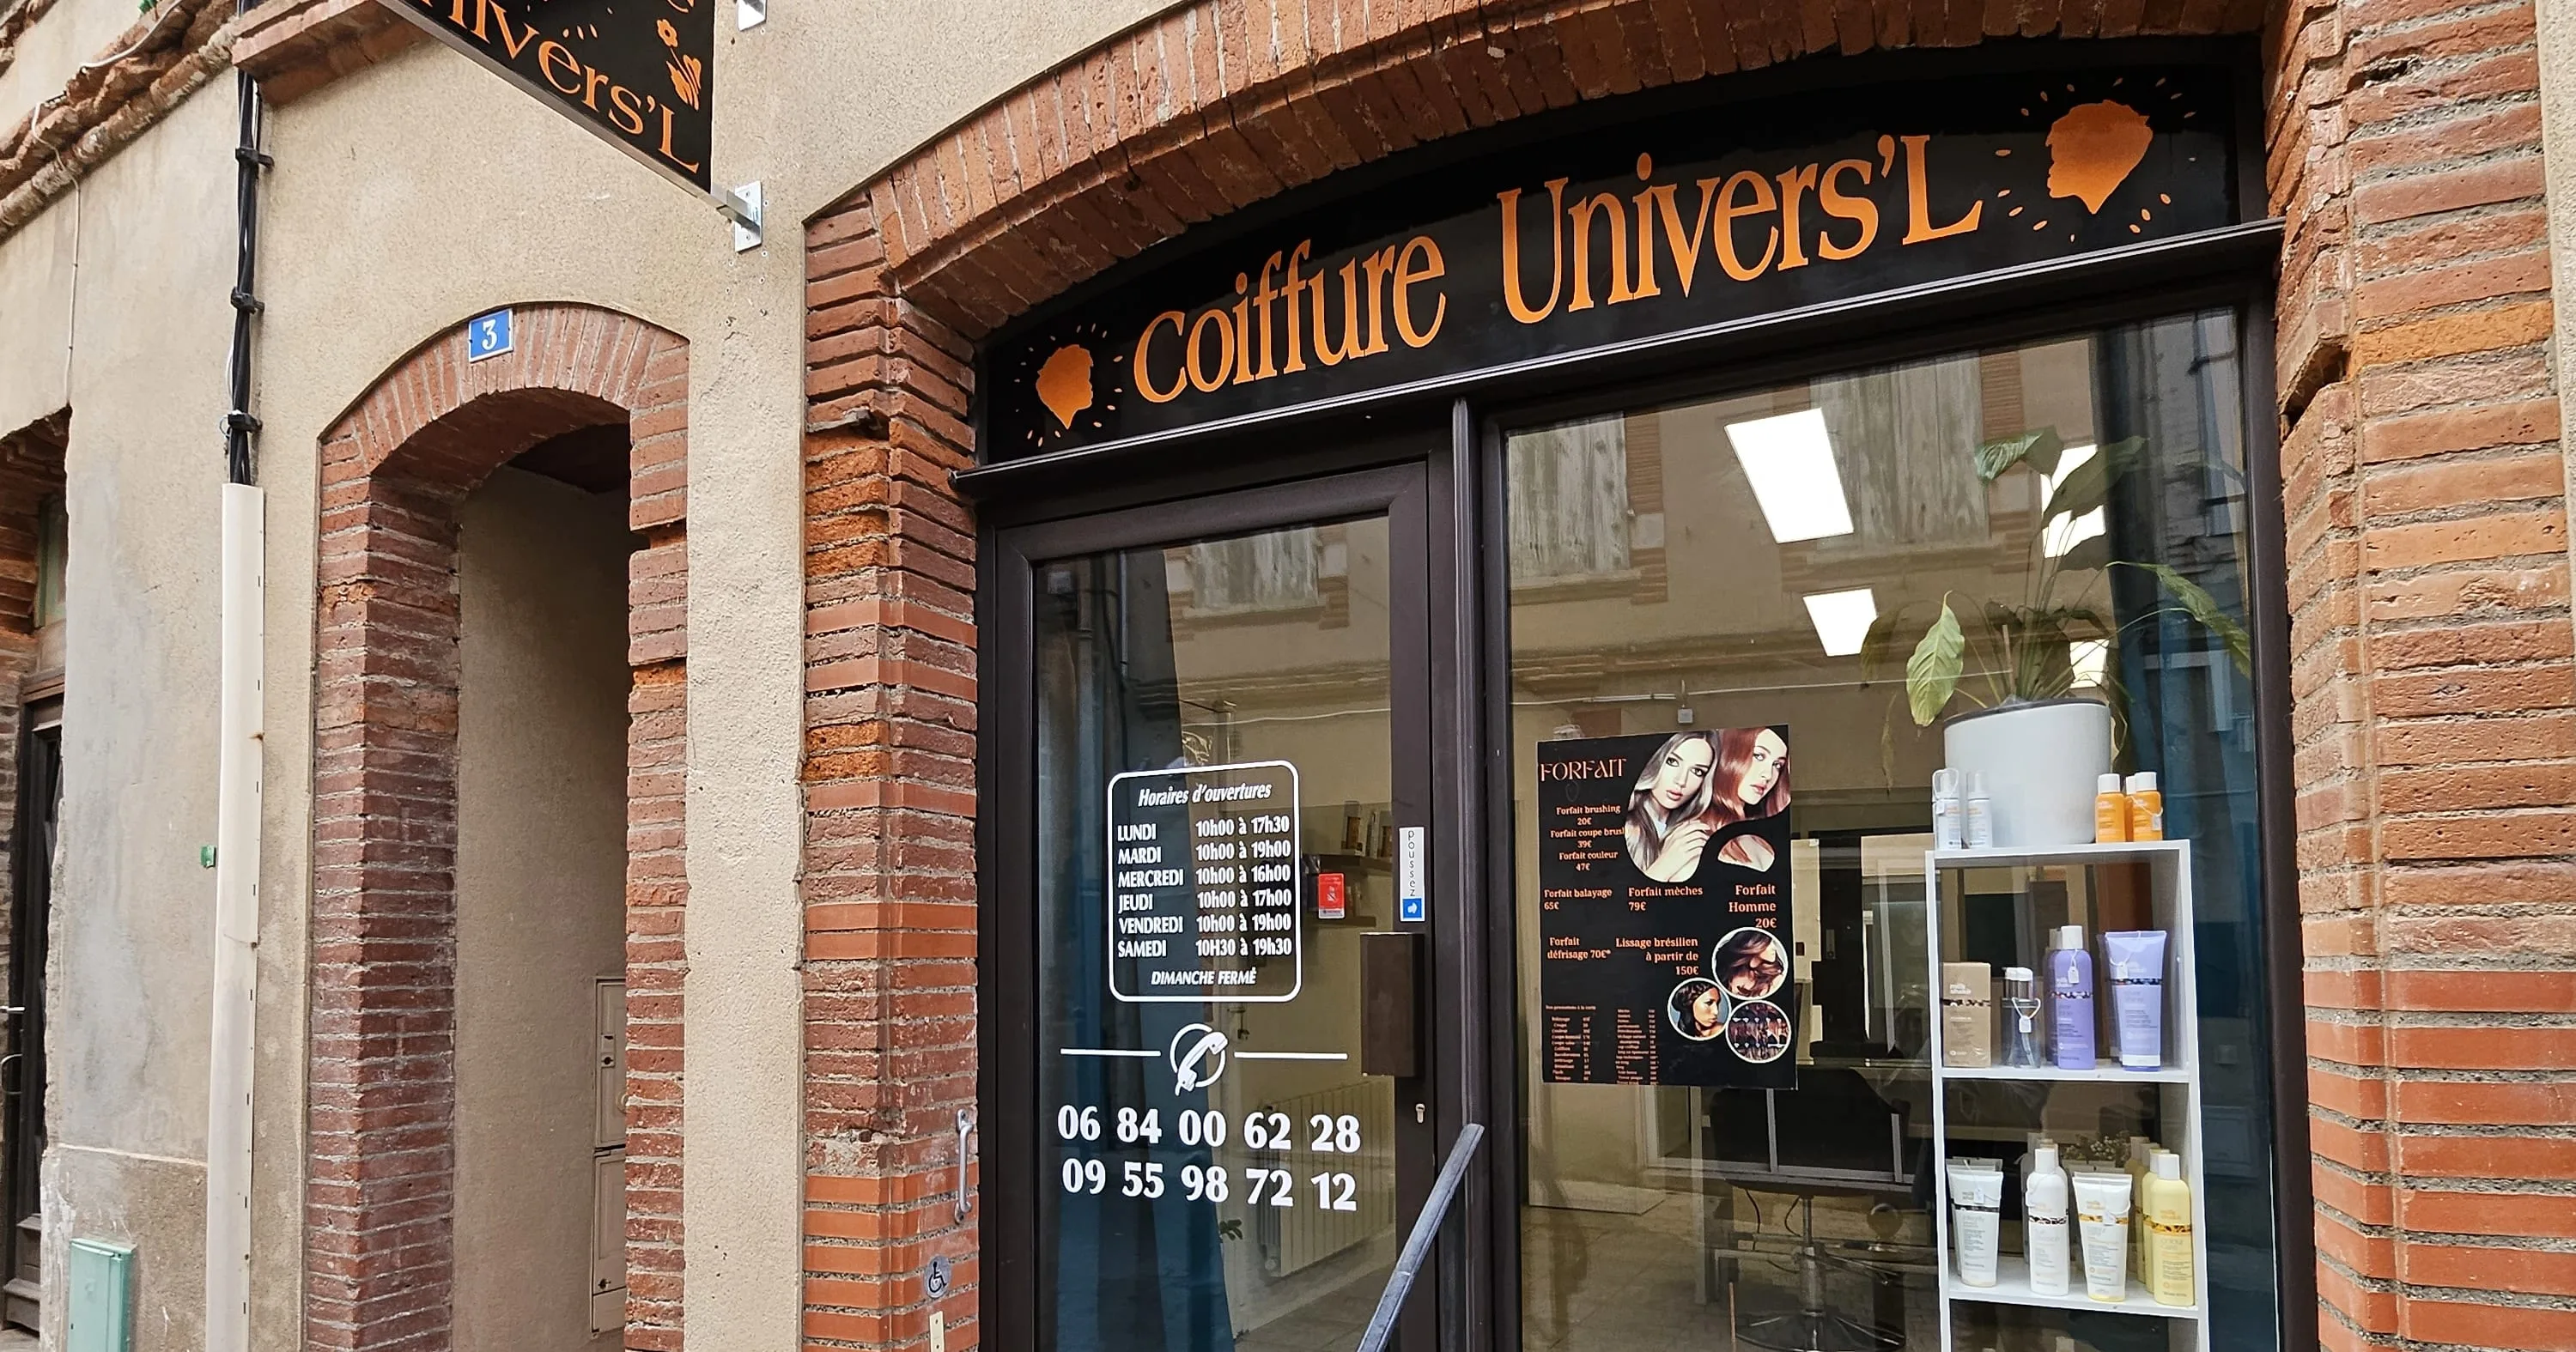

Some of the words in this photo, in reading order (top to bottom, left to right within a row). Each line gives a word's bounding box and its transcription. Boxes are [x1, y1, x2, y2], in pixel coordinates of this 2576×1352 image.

[1133, 235, 1446, 403] Coiffure
[1496, 133, 1984, 324] Univers'L
[482, 319, 497, 350] 3
[1540, 758, 1627, 781] FORFAIT
[1138, 786, 1188, 807] Horaires
[1193, 783, 1272, 803] d'ouvertures
[1584, 805, 1620, 814] brushing
[1117, 823, 1157, 842] LUNDI
[1196, 820, 1235, 838] 10h00
[1238, 817, 1247, 834] à
[1252, 816, 1290, 834] 17h30
[1117, 846, 1162, 864] MARDI
[1196, 843, 1235, 861] 10h00
[1238, 840, 1247, 858] à
[1252, 840, 1291, 858] 19h00
[1588, 851, 1618, 859] couleur
[1117, 869, 1184, 888] MERCREDI
[1196, 867, 1235, 885] 10h00
[1238, 866, 1247, 883] à
[1252, 864, 1291, 882] 16h00
[1544, 889, 1572, 898] Forfait
[1574, 888, 1613, 899] balayage
[1629, 887, 1662, 897] Forfait
[1664, 886, 1704, 895] mèches
[1735, 884, 1776, 895] Forfait
[1118, 894, 1153, 913] JEUDI
[1197, 891, 1236, 909] 10h00
[1240, 890, 1249, 907] à
[1252, 888, 1291, 906] 17h00
[1629, 902, 1646, 911] 79€
[1728, 901, 1777, 912] Homme
[1118, 916, 1183, 935] VENDREDI
[1196, 915, 1235, 932] 10h00
[1239, 914, 1248, 931] à
[1252, 913, 1291, 931] 19h00
[1755, 918, 1777, 928] 20€
[1117, 940, 1167, 958] SAMEDI
[1195, 938, 1236, 956] 10H30
[1240, 938, 1249, 956] à
[1252, 937, 1292, 955] 19h30
[1550, 937, 1579, 946] Forfait
[1616, 938, 1651, 949] Lissage
[1655, 937, 1698, 947] brésilien
[1547, 949, 1588, 961] défrisage
[1646, 952, 1651, 961] à
[1655, 952, 1684, 963] partir
[1686, 951, 1698, 961] de
[1151, 970, 1214, 985] DIMANCHE
[1218, 967, 1257, 985] FERMÉ
[1676, 966, 1698, 975] 150€
[1057, 1105, 1101, 1141] 06
[1116, 1107, 1162, 1143] 84
[1178, 1109, 1226, 1147] 00
[1243, 1112, 1292, 1150] 62
[1310, 1114, 1361, 1153] 28
[1062, 1158, 1106, 1194] 09
[1121, 1161, 1165, 1198] 55
[1181, 1166, 1229, 1203] 98
[1246, 1168, 1293, 1207] 72
[1311, 1172, 1357, 1211] 12
